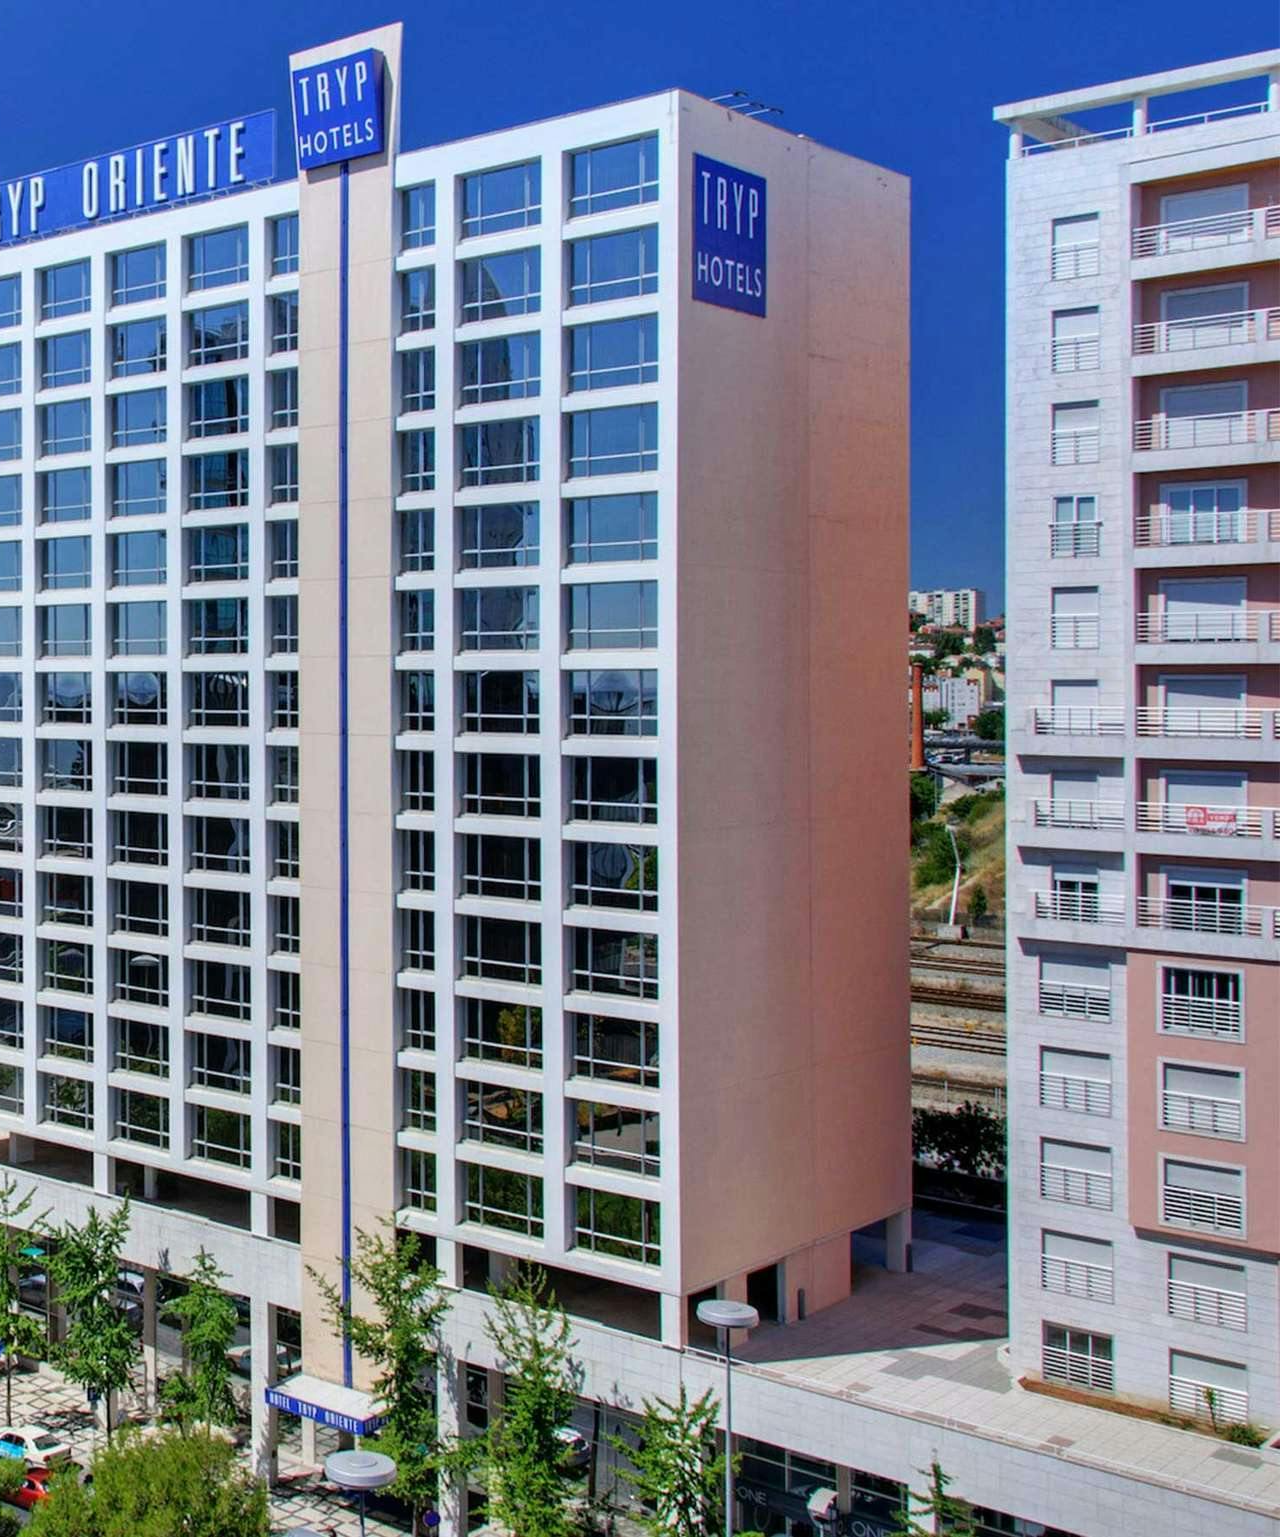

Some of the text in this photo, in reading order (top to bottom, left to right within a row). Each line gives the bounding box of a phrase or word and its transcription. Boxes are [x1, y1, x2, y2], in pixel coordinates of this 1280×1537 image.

[299, 60, 368, 116] TRYP
[299, 117, 375, 157] HOTELS
[82, 121, 246, 219] ORIENTE
[701, 171, 759, 239] TRYP
[697, 251, 762, 298] HOTELS
[297, 1401, 318, 1417] TRYP
[324, 1411, 358, 1433] ORIENTE
